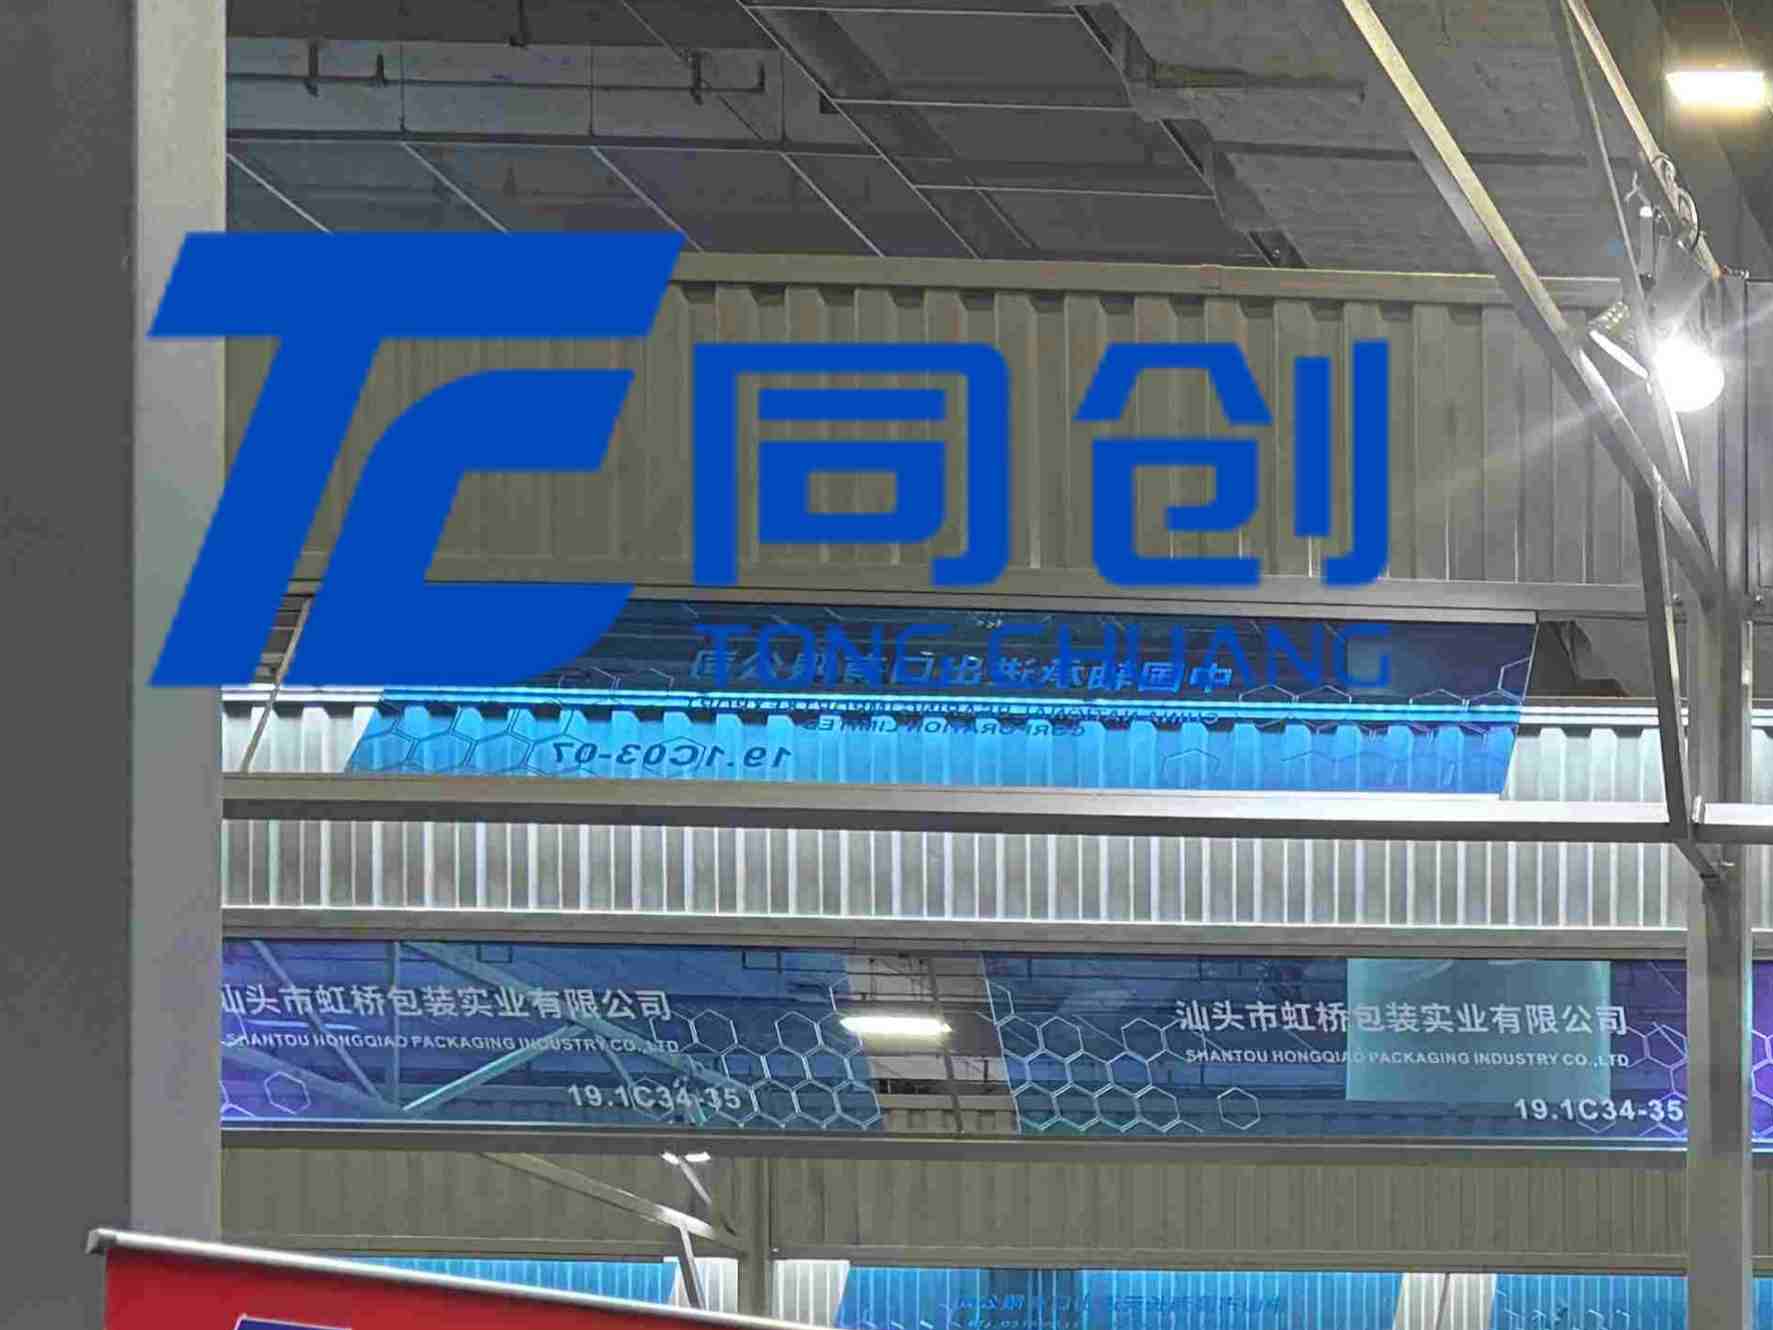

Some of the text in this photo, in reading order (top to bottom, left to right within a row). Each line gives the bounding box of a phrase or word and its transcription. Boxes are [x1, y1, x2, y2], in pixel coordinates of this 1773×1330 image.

[1176, 1000, 1628, 1038] 汕头市虹桥包装实业有限公司
[412, 1035, 514, 1051] PACKAGING
[1185, 1047, 1269, 1065] SHANTOU
[1369, 1050, 1471, 1067] PACKAGING
[1474, 1051, 1559, 1068] INDUSTRY
[567, 1082, 741, 1109] 19.1C34-35
[1515, 1097, 1684, 1122] 19.1C34-35
